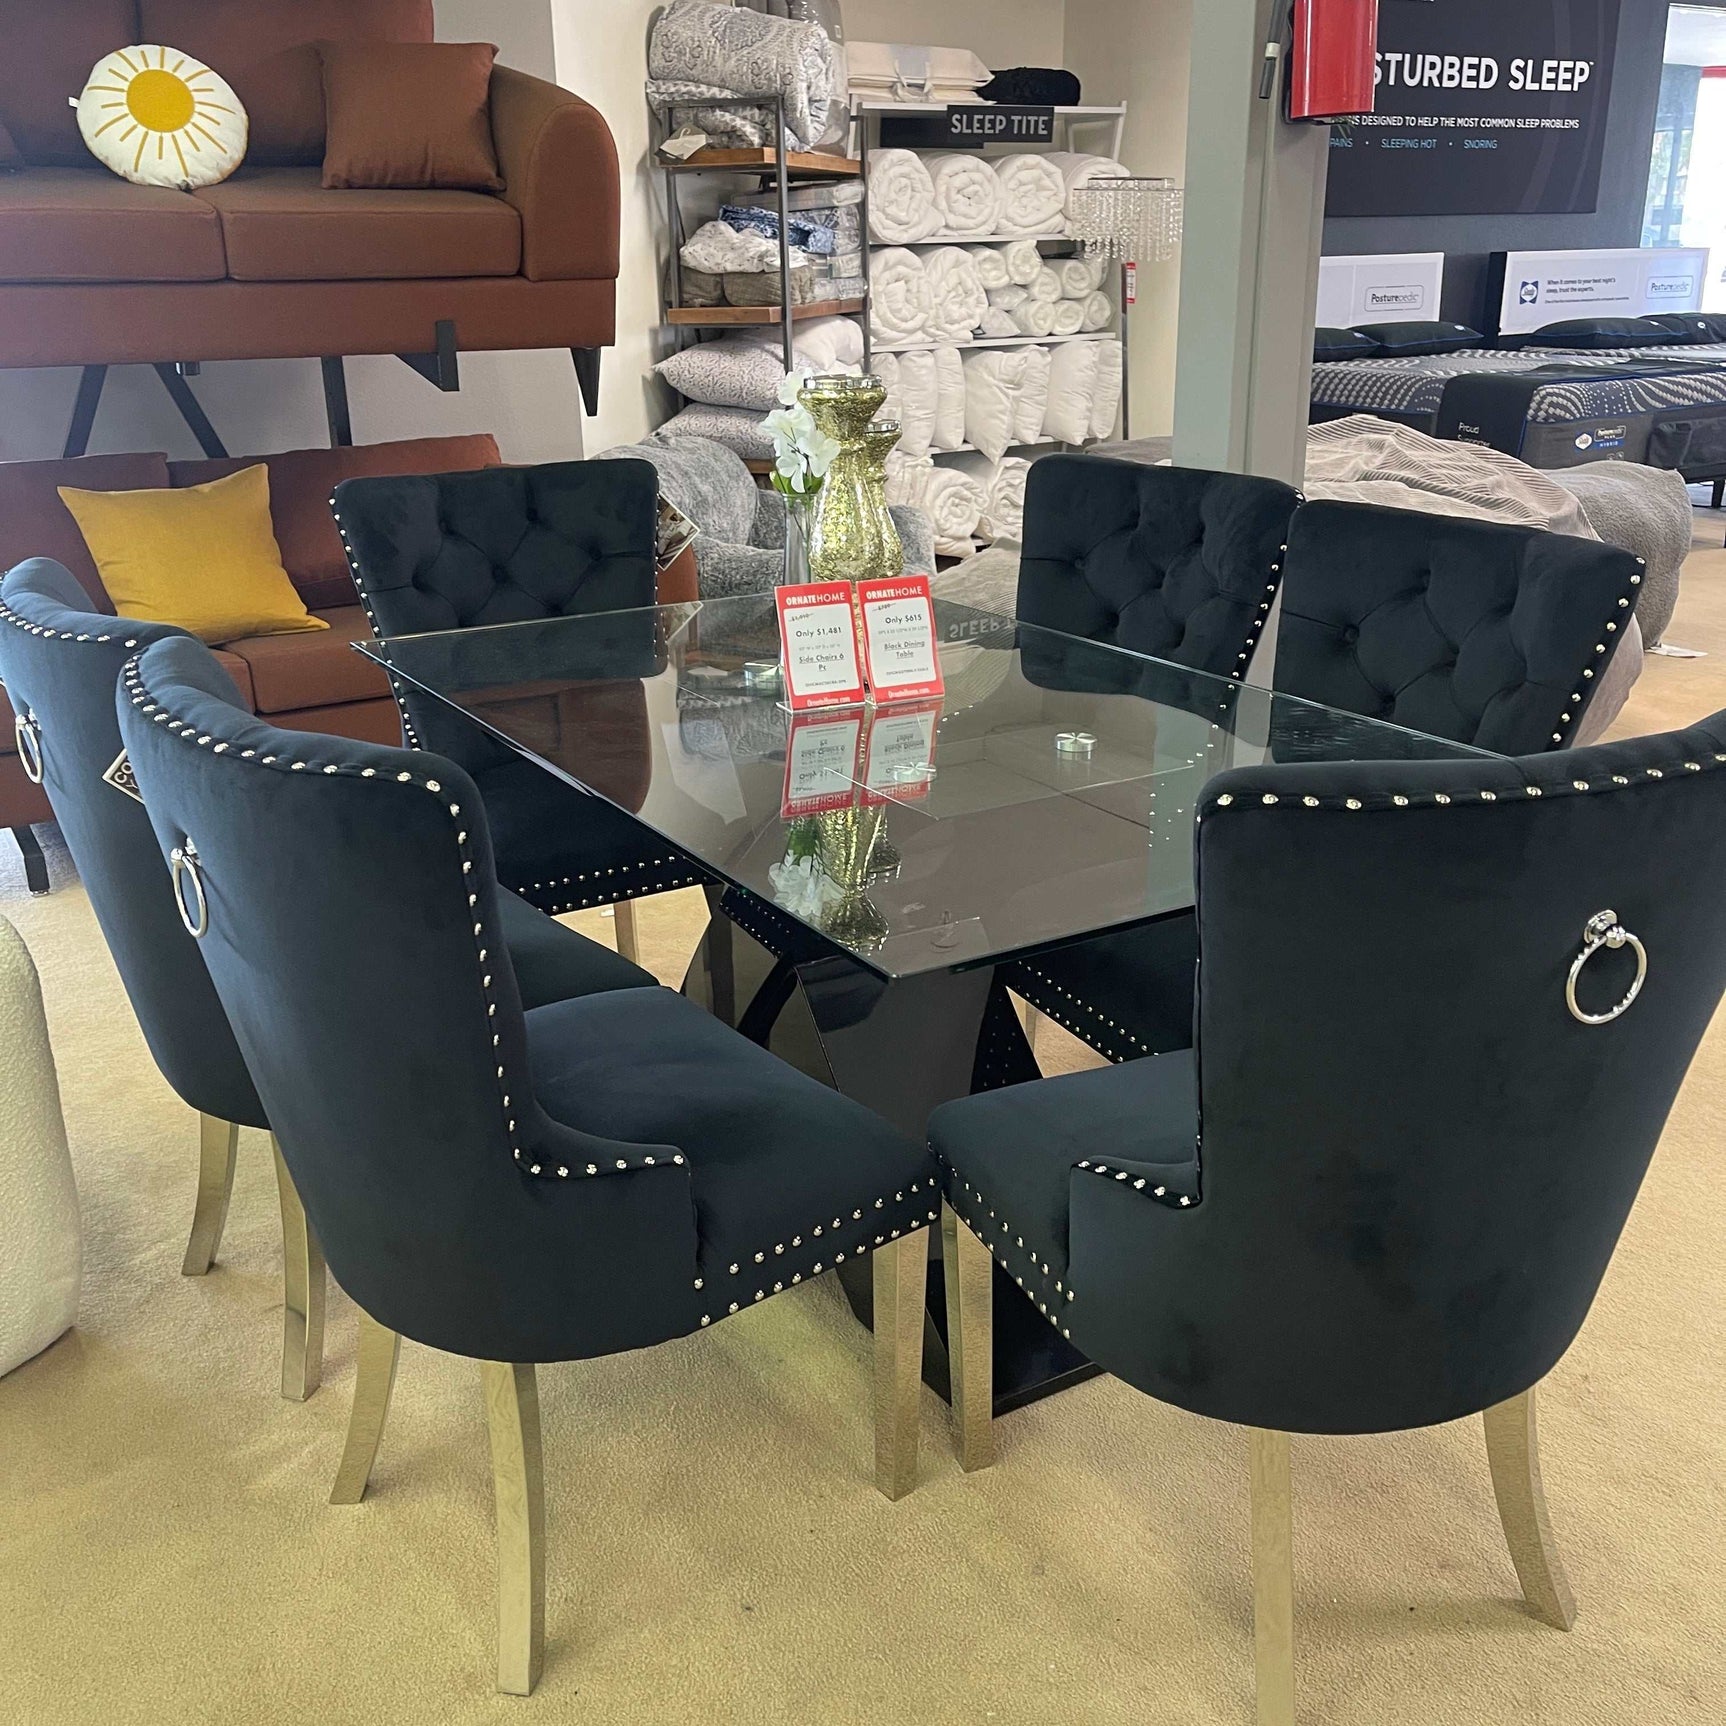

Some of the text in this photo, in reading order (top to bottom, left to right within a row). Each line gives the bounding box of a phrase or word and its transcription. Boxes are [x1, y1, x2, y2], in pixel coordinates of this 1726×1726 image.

[950, 113, 1049, 135] SLEEP TITE
[1361, 115, 1404, 126] DESIGNED
[1405, 116, 1417, 127] TO
[1417, 116, 1440, 127] HELP
[1440, 117, 1456, 127] THE
[1456, 117, 1479, 128] MOST
[1480, 117, 1516, 128] COMMON
[1516, 118, 1540, 129] SLEEP
[1540, 118, 1580, 129] PROBLEMS
[1381, 138, 1438, 149] SLEEPING HOT
[1463, 139, 1498, 149] SNORING
[1458, 422, 1480, 434] Proud
[885, 614, 922, 624] Only $615
[795, 626, 842, 638] Only $1,481
[884, 640, 925, 650] Black Dining
[799, 656, 814, 664] Side
[816, 654, 838, 662] Chairs
[896, 650, 914, 658] Table
